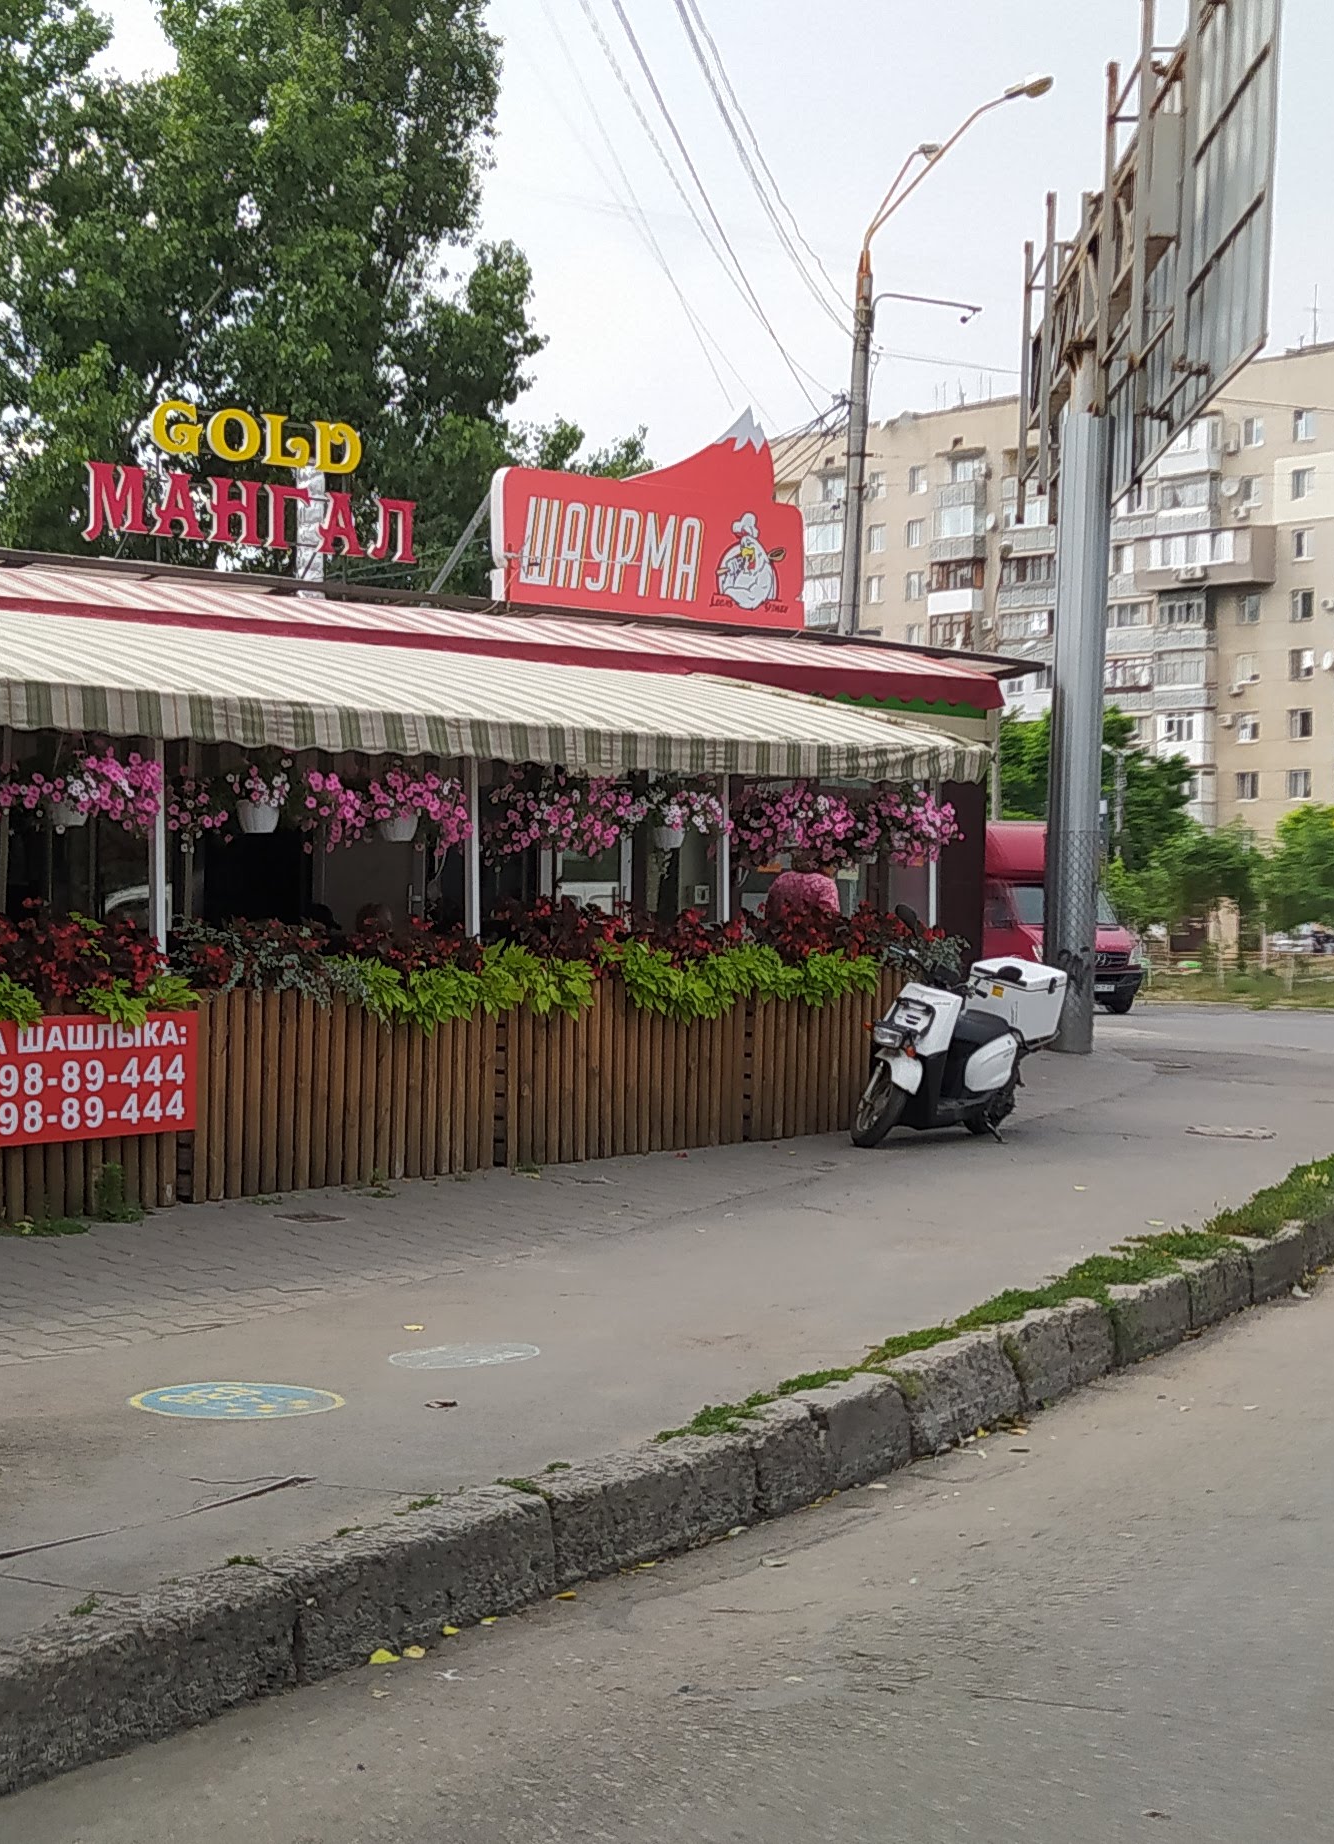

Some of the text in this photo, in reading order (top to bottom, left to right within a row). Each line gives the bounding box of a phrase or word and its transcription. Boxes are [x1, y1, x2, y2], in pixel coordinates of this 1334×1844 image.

[151, 400, 363, 474] GOLD
[81, 461, 417, 563] МАНГАЛ
[519, 496, 705, 602] ШАУРМА
[16, 1021, 187, 1055] ШАШЛЫКА:
